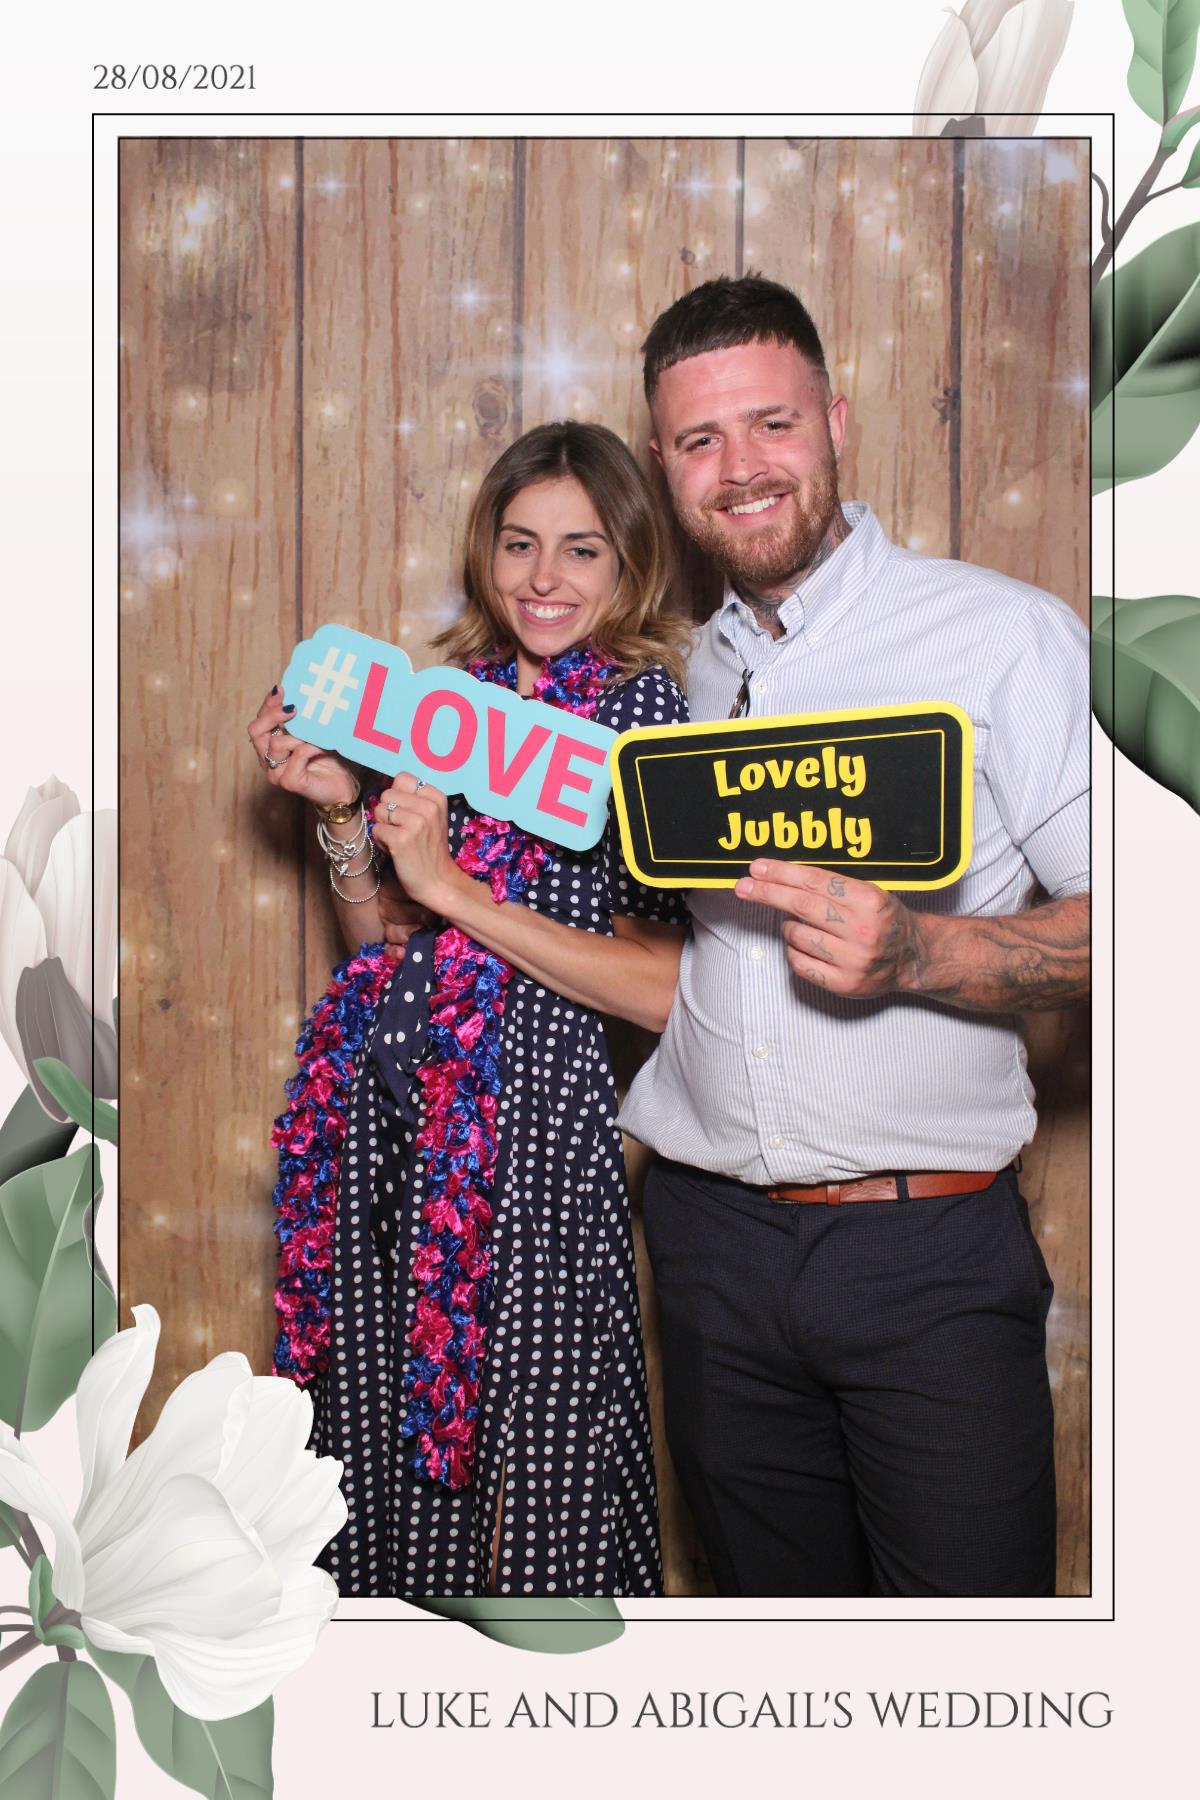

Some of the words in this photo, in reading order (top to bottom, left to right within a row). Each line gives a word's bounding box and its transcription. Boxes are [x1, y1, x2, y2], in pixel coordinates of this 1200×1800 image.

[299, 647, 608, 828] #LOVE
[713, 746, 866, 797] Lovely
[718, 807, 872, 858] Jubbly
